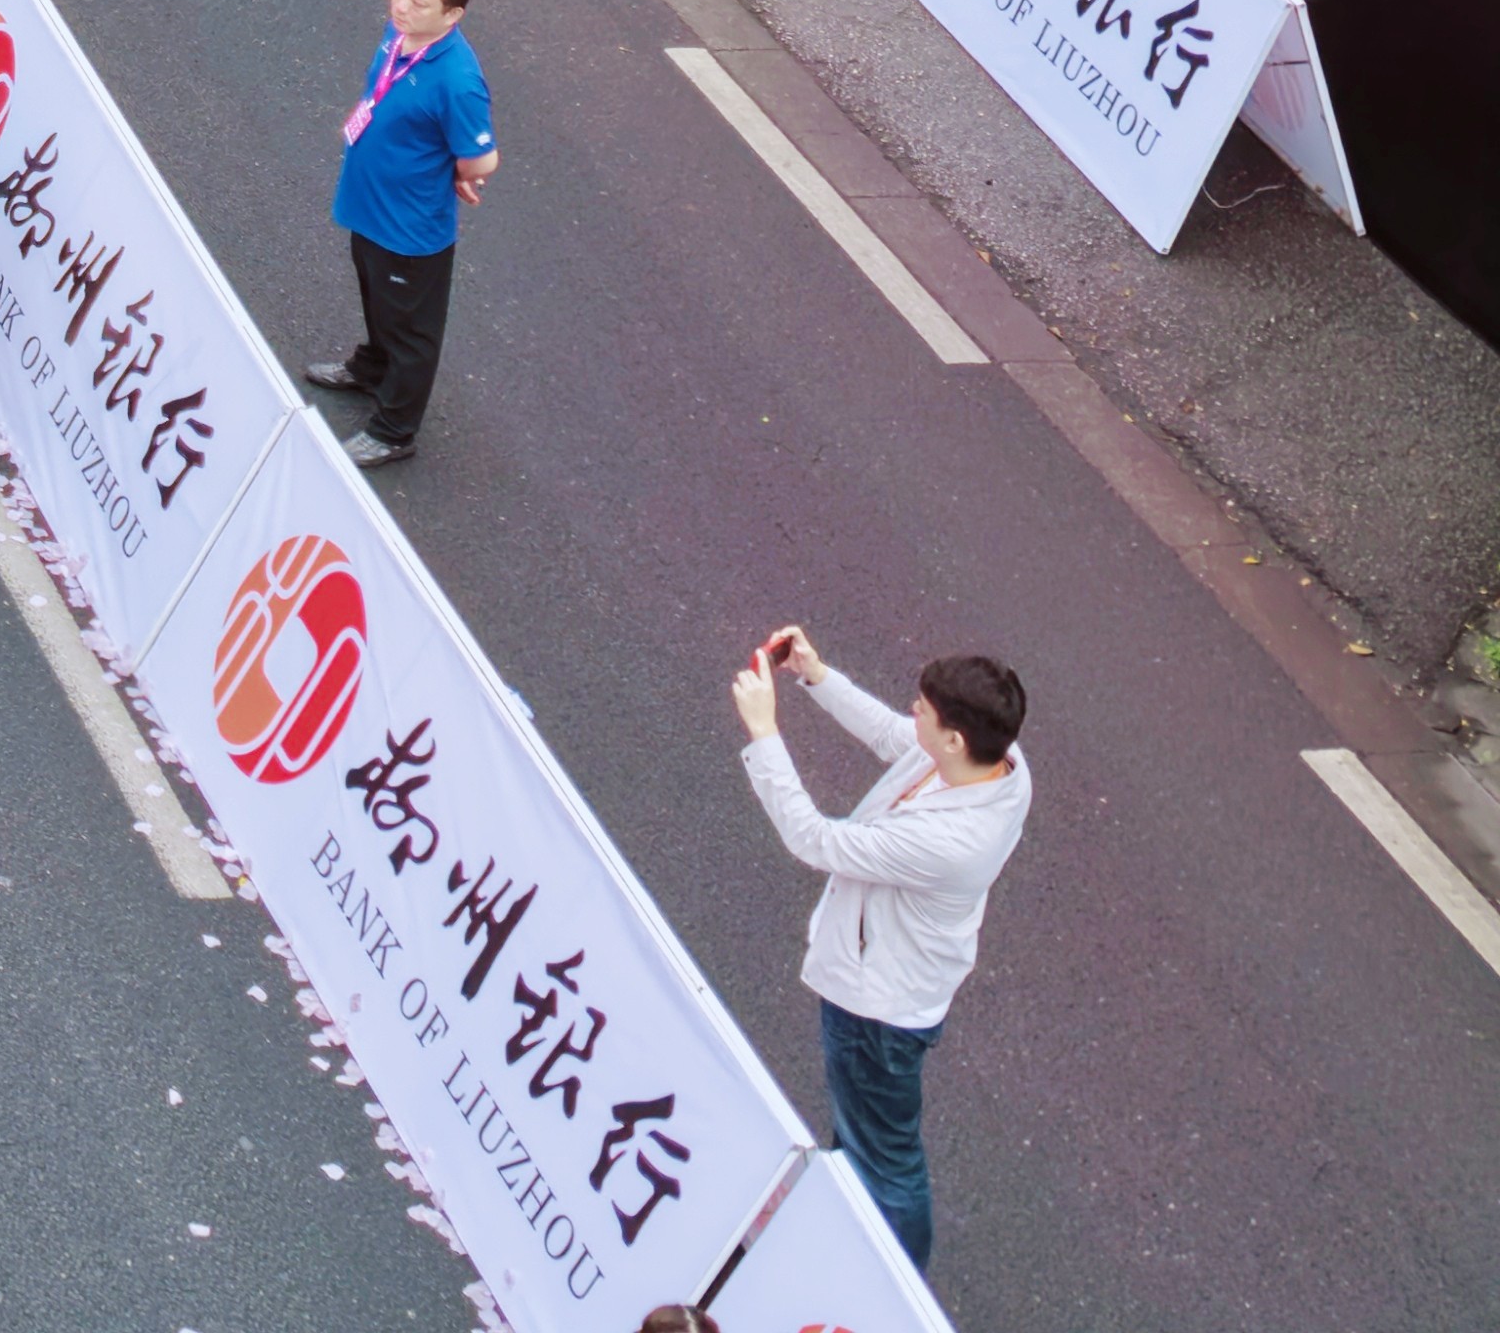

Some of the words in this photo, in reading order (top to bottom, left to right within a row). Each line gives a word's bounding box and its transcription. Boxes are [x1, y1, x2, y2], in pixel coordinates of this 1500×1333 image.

[1033, 20, 1160, 159] LIUZHOU
[23, 339, 54, 393] OF
[48, 390, 148, 562] LIUZHOU
[311, 831, 403, 979] BANK
[397, 975, 448, 1053] OF
[442, 1046, 606, 1304] LIUZHOU
[345, 714, 691, 1251] 柳州银行
